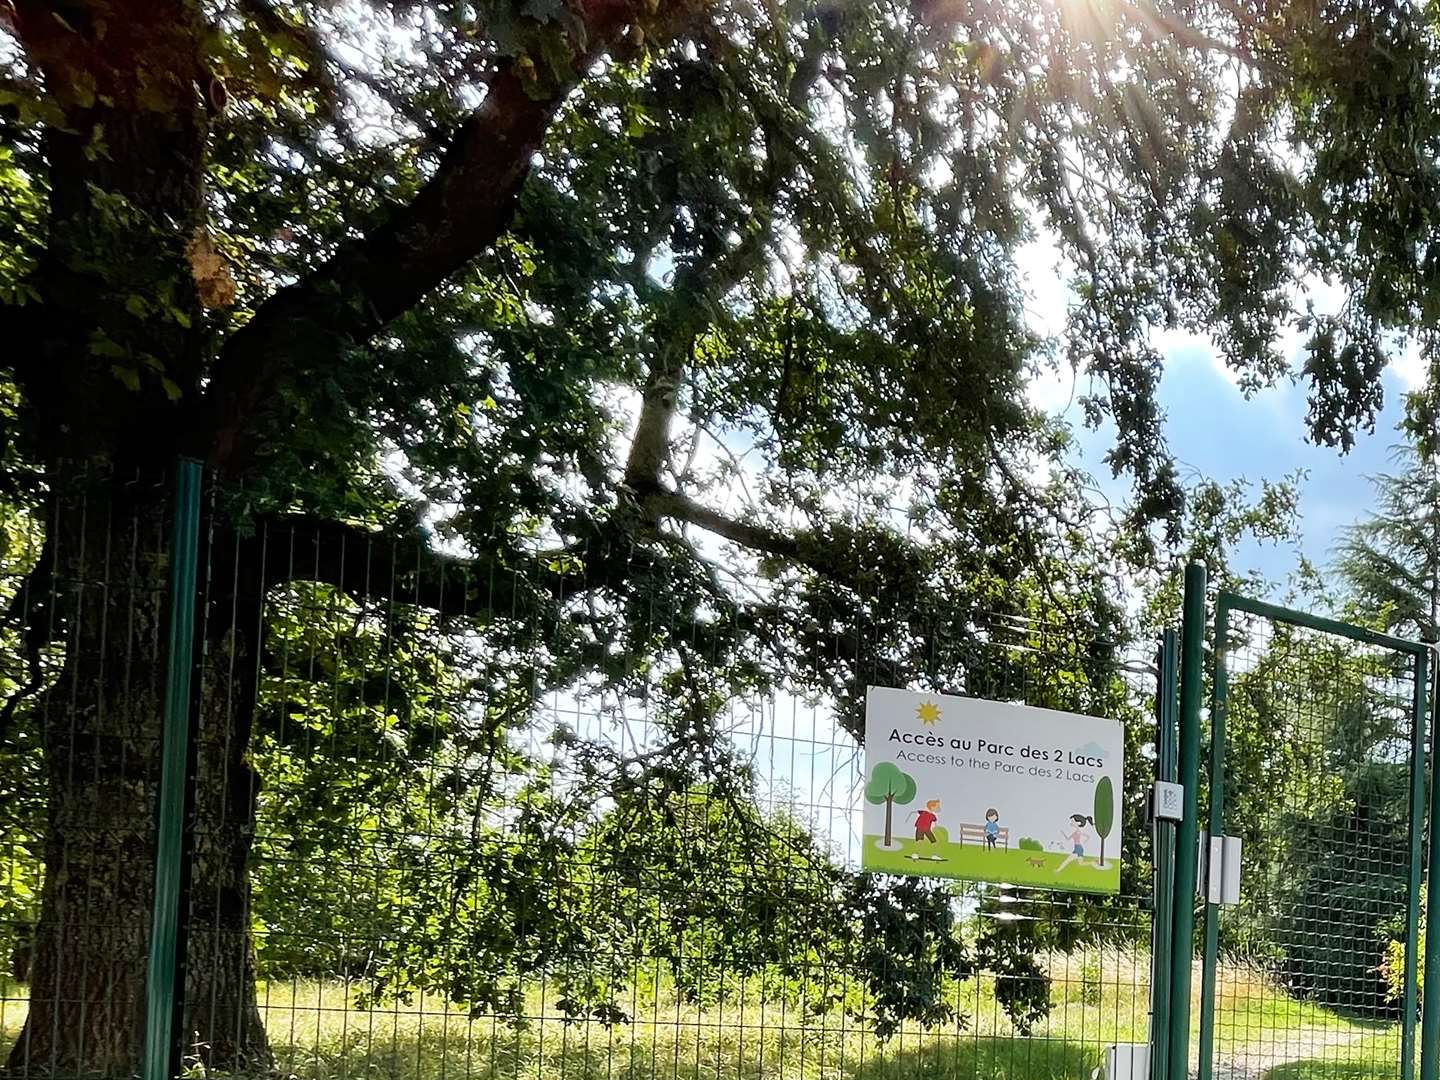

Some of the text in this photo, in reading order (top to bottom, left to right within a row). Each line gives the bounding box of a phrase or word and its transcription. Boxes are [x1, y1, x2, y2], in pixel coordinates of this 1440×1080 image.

[889, 729, 1103, 768] Accès au Parc des 2 Lacs
[896, 750, 1095, 783] Access to the Parc des 2 Lacs
